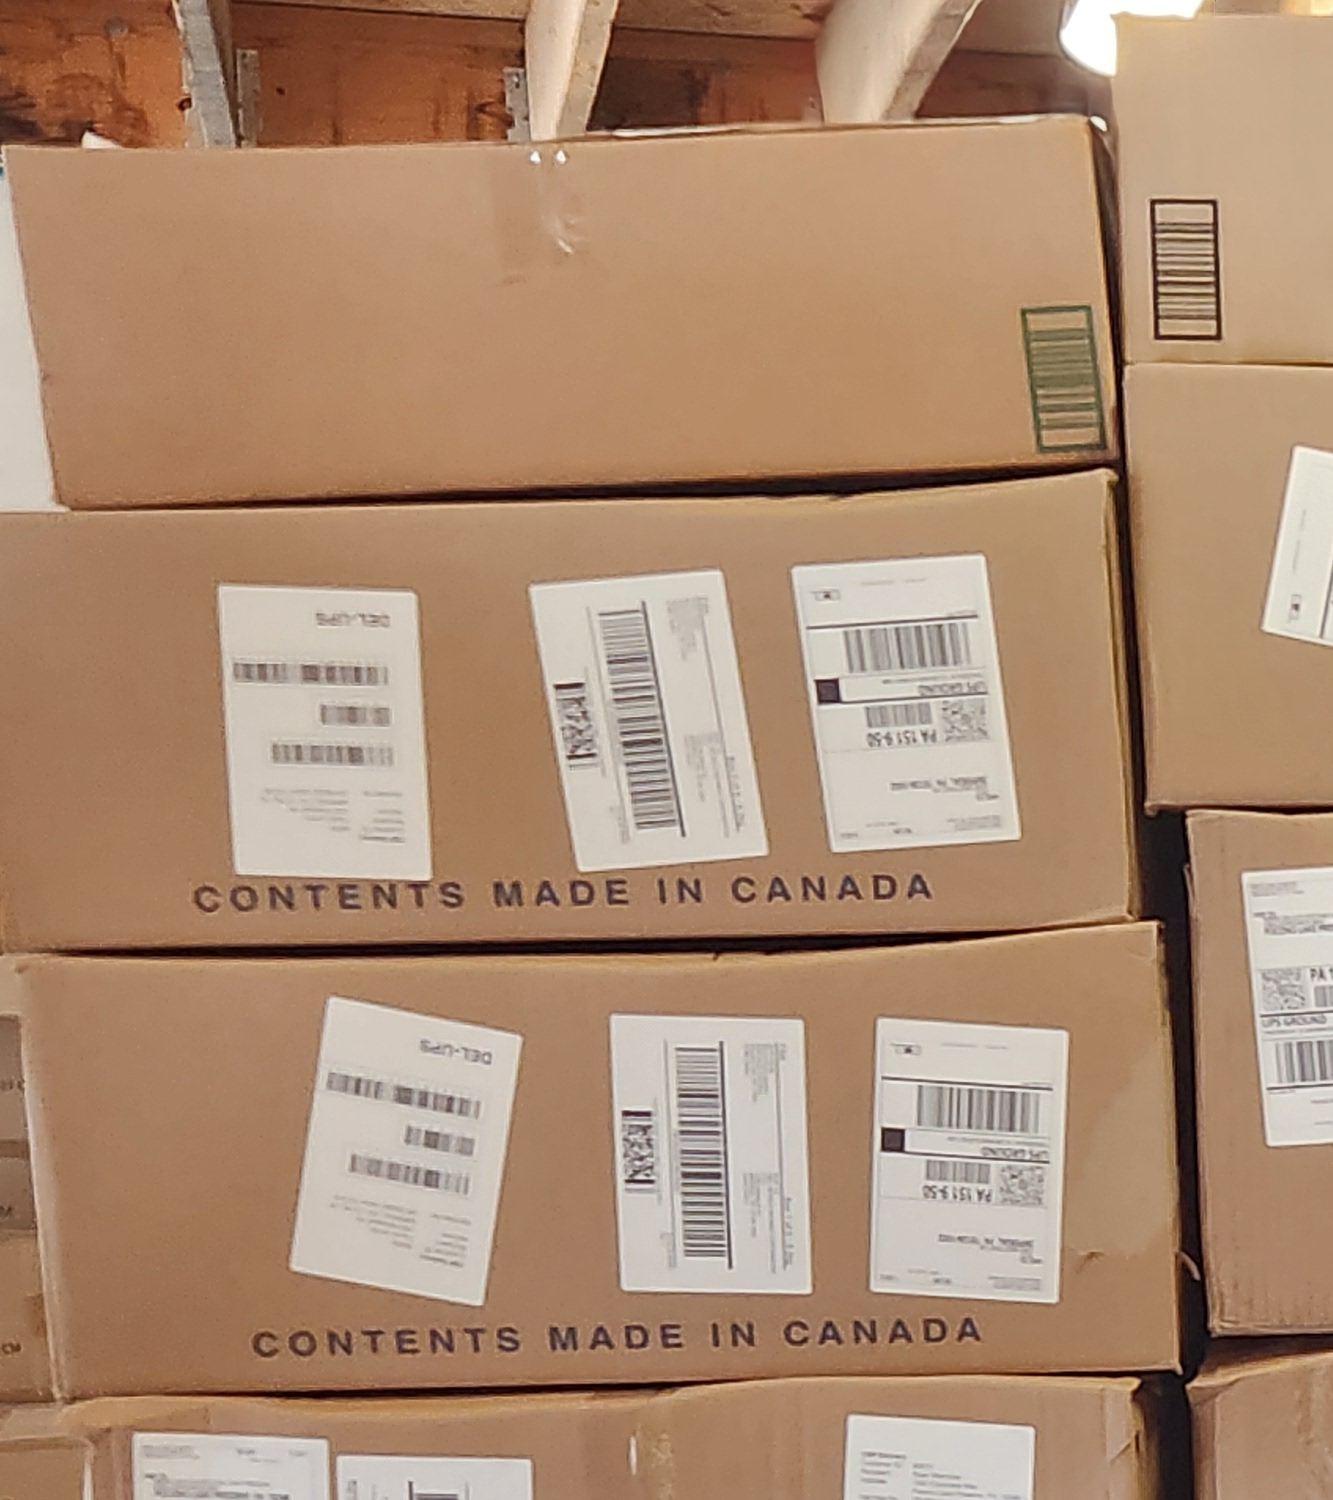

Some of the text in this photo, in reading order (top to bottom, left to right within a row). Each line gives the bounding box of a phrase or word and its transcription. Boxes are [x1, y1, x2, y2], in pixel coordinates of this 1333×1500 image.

[194, 874, 932, 912] CONTENTS MADE IN CANADA
[420, 1040, 493, 1066] DEL-UPS
[252, 1318, 982, 1358] CONTENTS MADE IN CANADA
